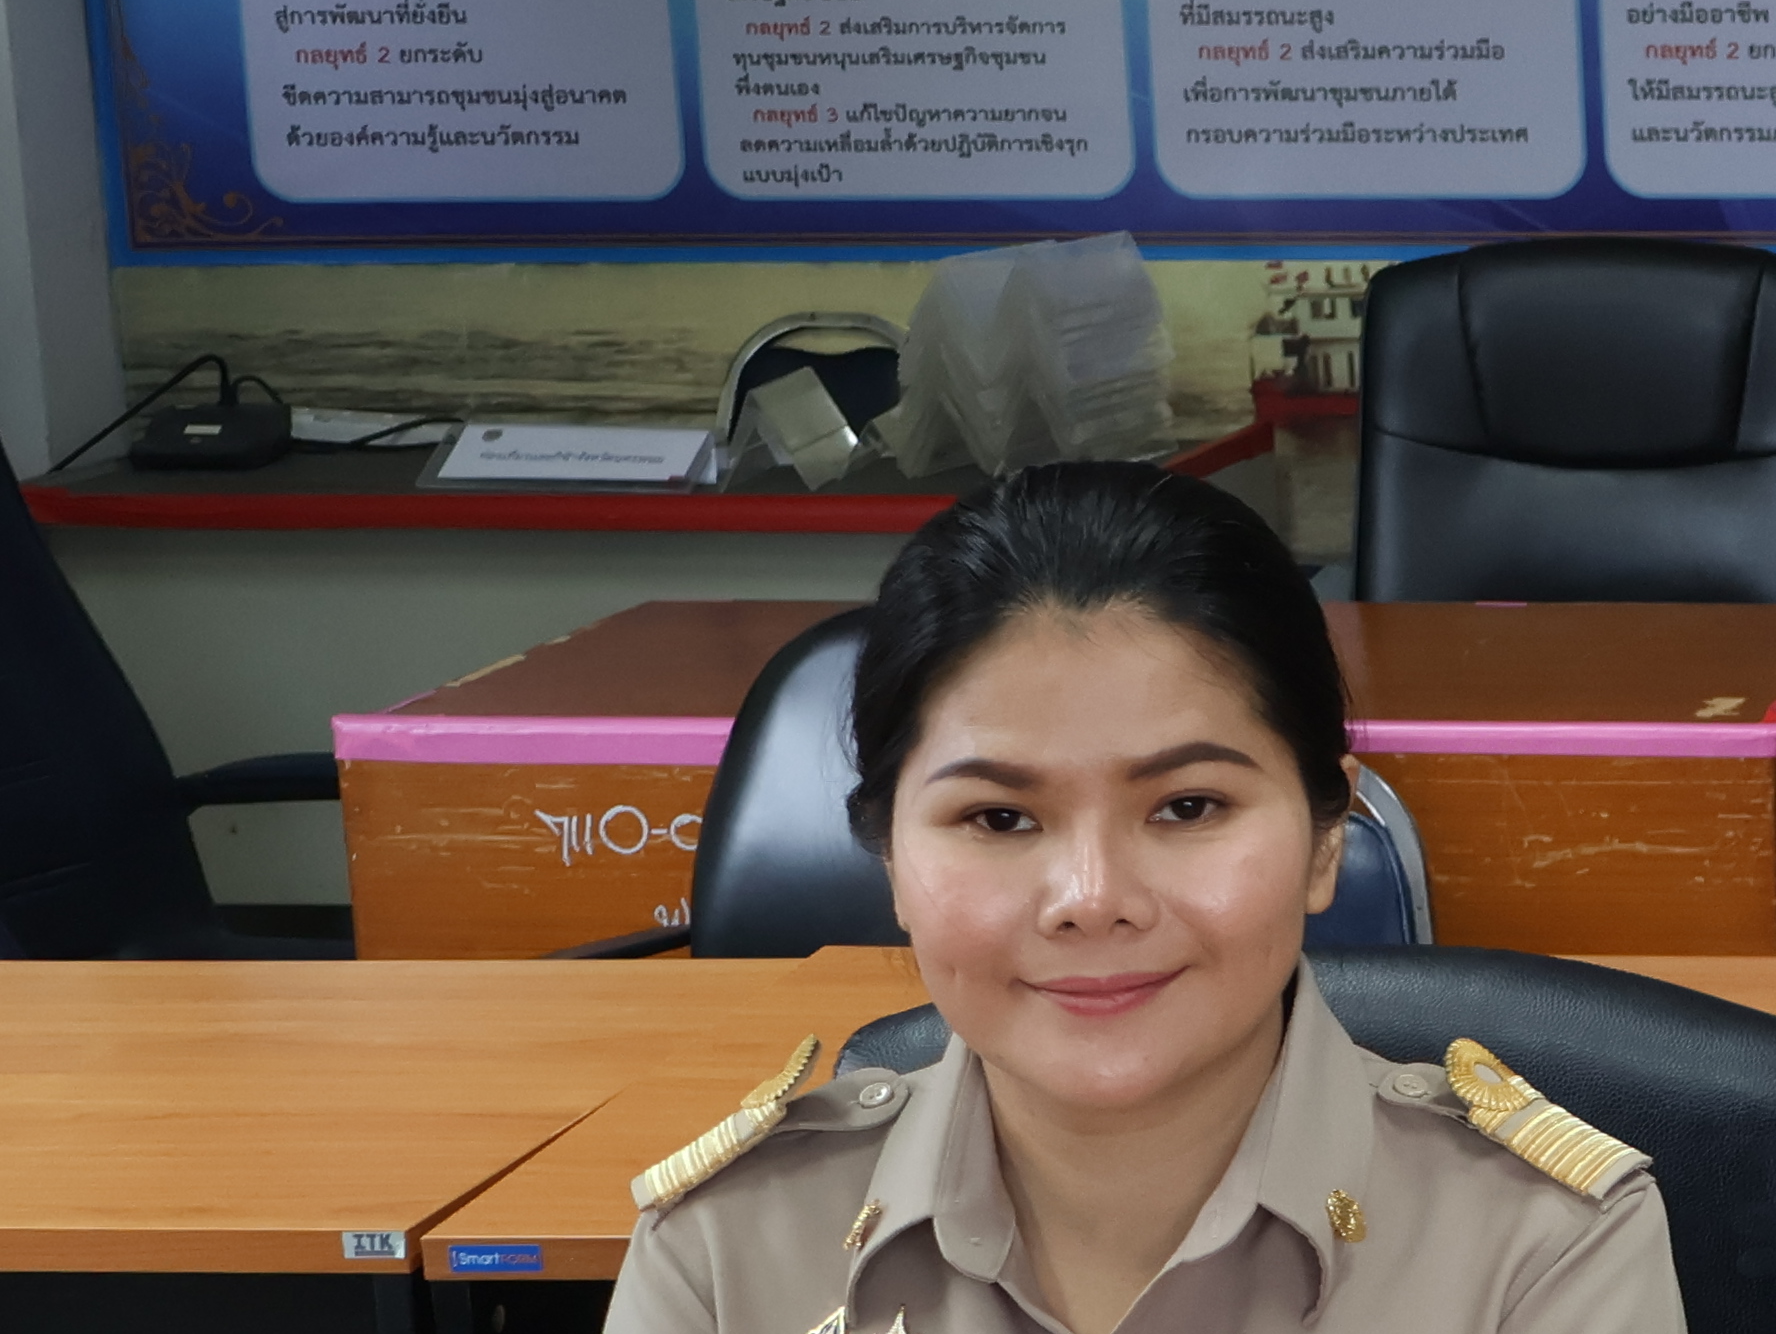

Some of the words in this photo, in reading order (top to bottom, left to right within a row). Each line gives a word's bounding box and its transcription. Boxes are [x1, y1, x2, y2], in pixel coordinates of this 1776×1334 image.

[819, 21, 830, 35] 2
[378, 48, 391, 63] 2
[1280, 45, 1291, 60] 2
[1727, 45, 1739, 59] 2
[827, 108, 839, 122] 3
